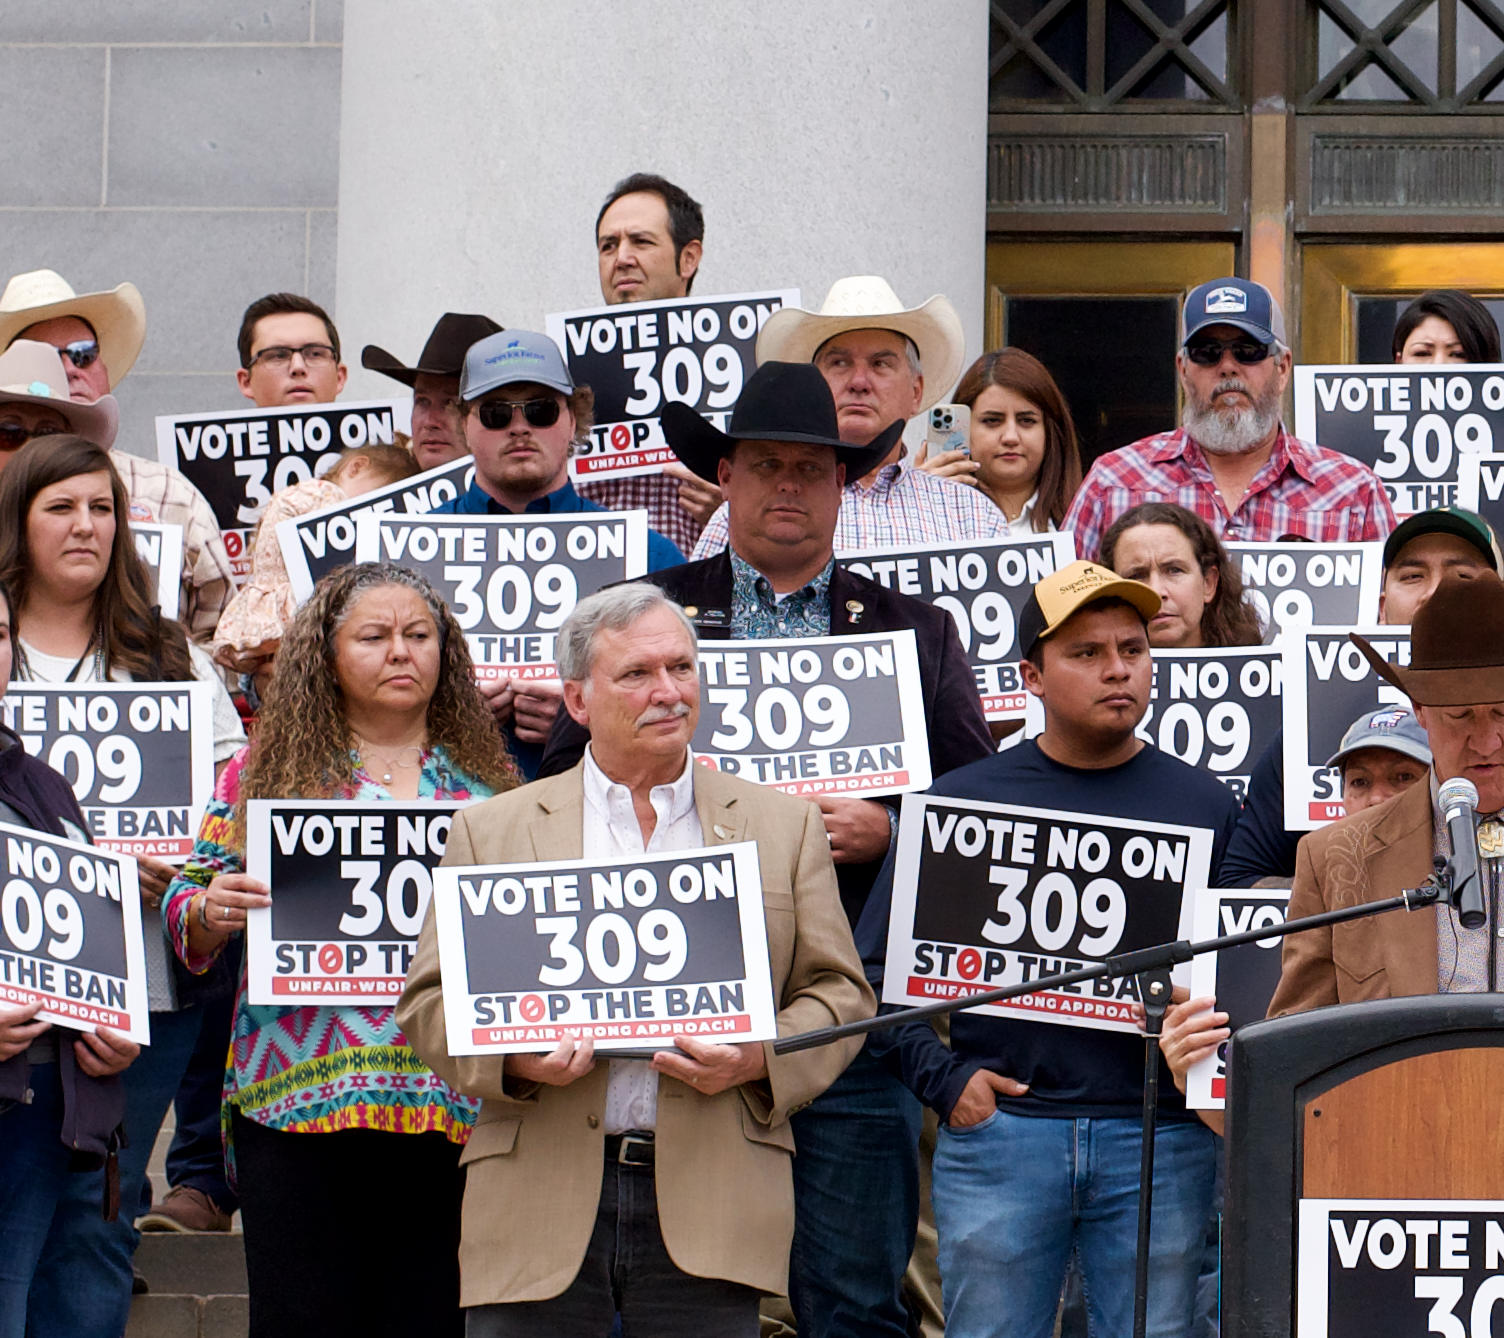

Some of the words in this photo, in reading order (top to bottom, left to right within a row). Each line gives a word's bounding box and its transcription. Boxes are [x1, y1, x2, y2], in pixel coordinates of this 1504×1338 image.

[565, 314, 659, 355] VOTE
[668, 308, 719, 345] NO
[624, 343, 742, 416] 309
[1315, 377, 1411, 411] VOTE
[1421, 376, 1472, 410] NO
[176, 422, 270, 459] VOTE
[278, 417, 330, 453] NO
[340, 412, 394, 448] ON
[380, 527, 486, 562] VOTE
[499, 526, 555, 561] NO
[567, 526, 624, 561] ON
[442, 564, 576, 630] 309
[761, 649, 822, 683] NO
[833, 645, 893, 679] ON
[58, 696, 117, 731] NO
[129, 696, 188, 731] ON
[707, 683, 850, 752] 309
[750, 752, 820, 781] THE
[829, 746, 902, 775] BAN
[801, 776, 893, 793] APPROACH
[272, 815, 385, 855] VOTE
[926, 811, 1038, 864] VOTE
[1048, 827, 1110, 873] NO
[1122, 837, 1185, 883] ON
[6, 839, 60, 884] NO
[69, 855, 121, 900] ON
[461, 875, 580, 916] VOTE
[591, 870, 657, 909] NO
[669, 865, 736, 904] ON
[981, 865, 1127, 957] 309
[536, 909, 687, 986] 309
[64, 968, 127, 1007] BAN
[581, 989, 654, 1020] THE
[665, 984, 745, 1016] BAN
[634, 1020, 735, 1035] APPROACH
[1330, 1219, 1469, 1269] VOTE
